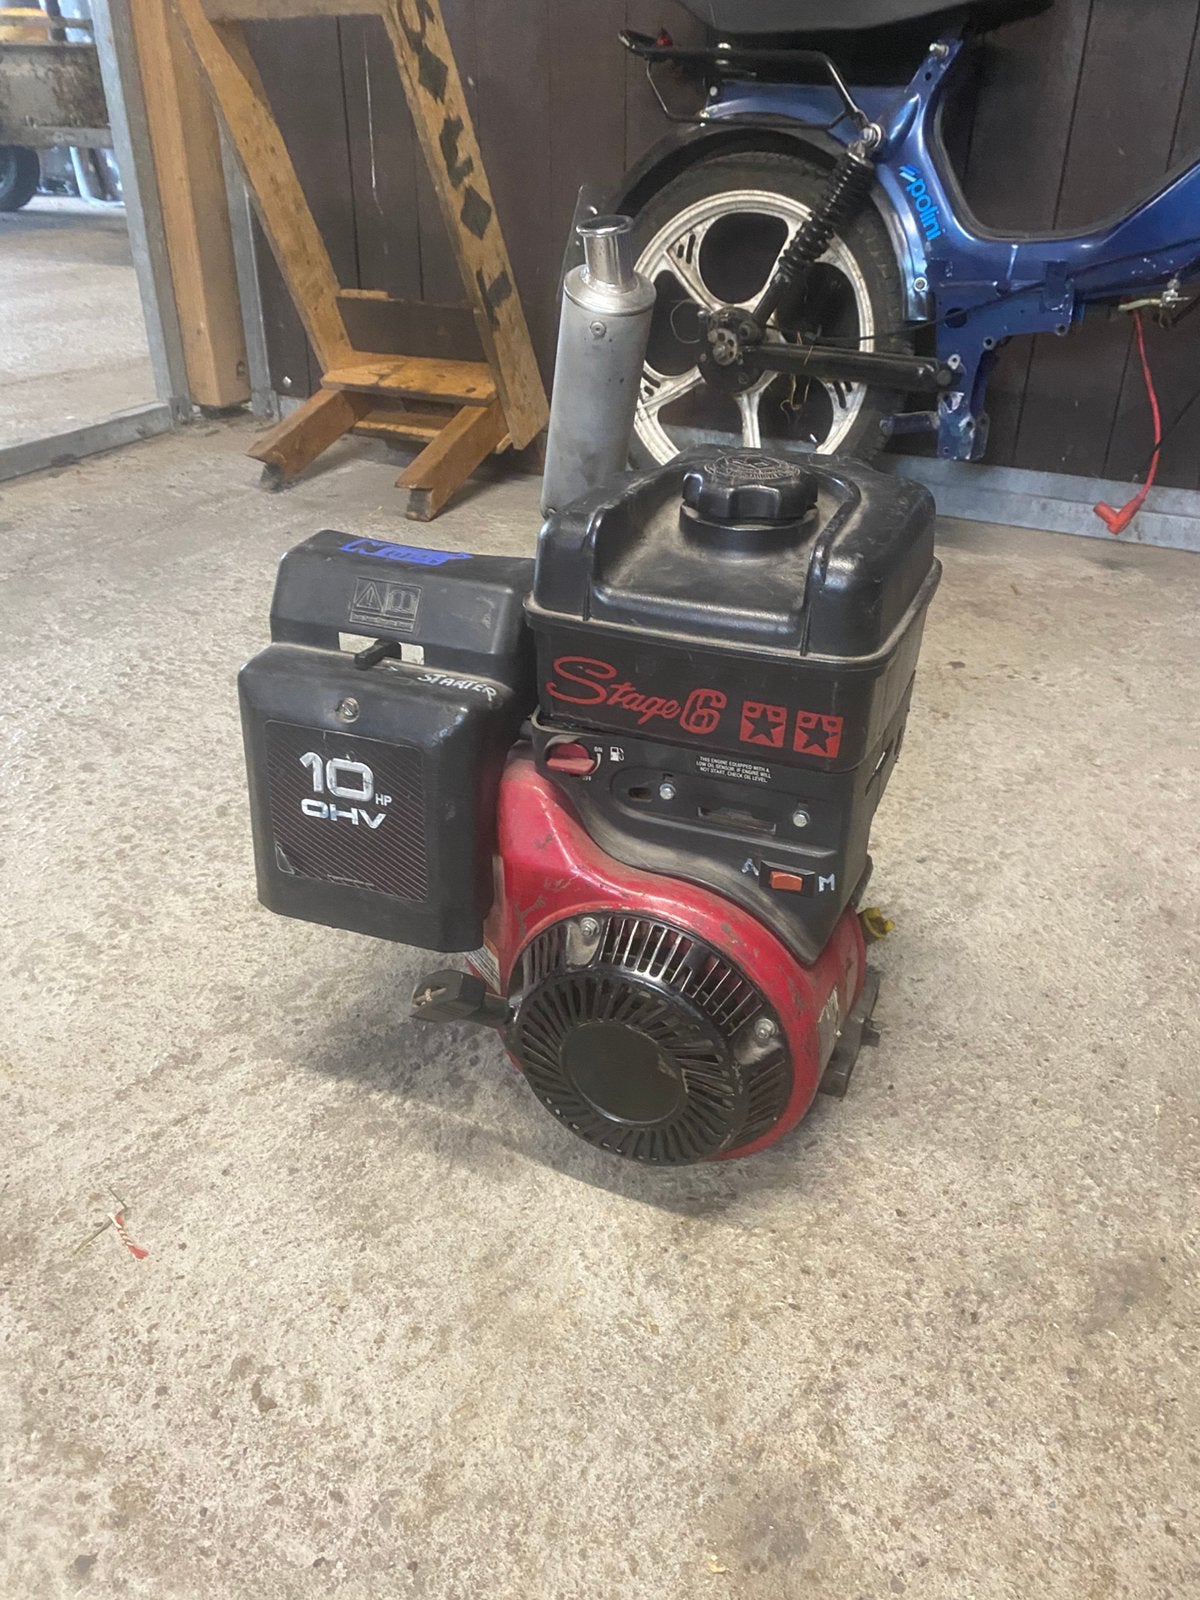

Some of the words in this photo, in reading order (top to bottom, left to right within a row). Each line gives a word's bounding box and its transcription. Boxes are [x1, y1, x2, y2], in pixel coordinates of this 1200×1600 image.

[906, 178, 946, 240] polini
[417, 673, 497, 702] STARTER
[299, 751, 374, 801] 10
[375, 793, 393, 807] HP
[729, 761, 753, 770] EQUIPPED
[301, 798, 387, 829] OHV
[818, 873, 836, 892] M
